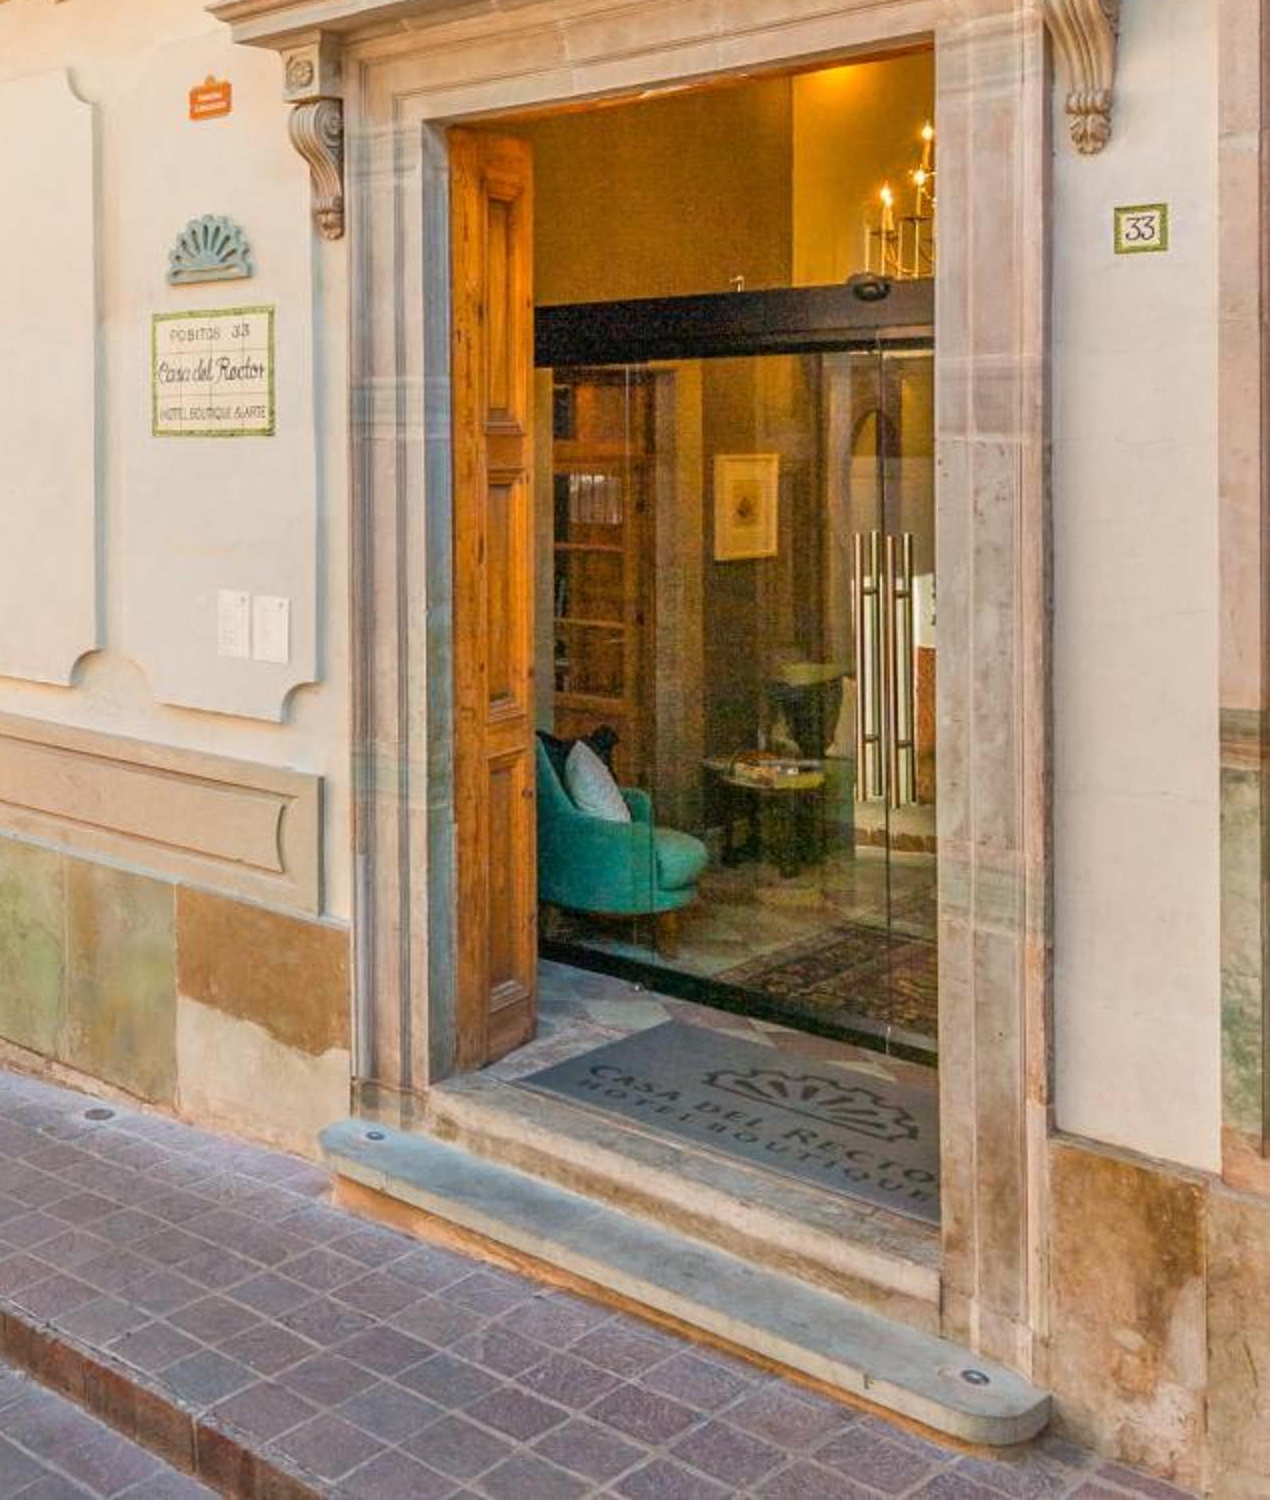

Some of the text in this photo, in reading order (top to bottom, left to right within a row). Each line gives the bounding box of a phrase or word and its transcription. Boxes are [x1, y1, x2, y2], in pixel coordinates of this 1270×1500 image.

[1125, 215, 1155, 241] 33
[231, 323, 250, 339] 33
[192, 357, 213, 381] del
[215, 356, 265, 384] Rector
[577, 1078, 695, 1124] HOTEL
[589, 1064, 940, 1191] CASA DEL RECTO
